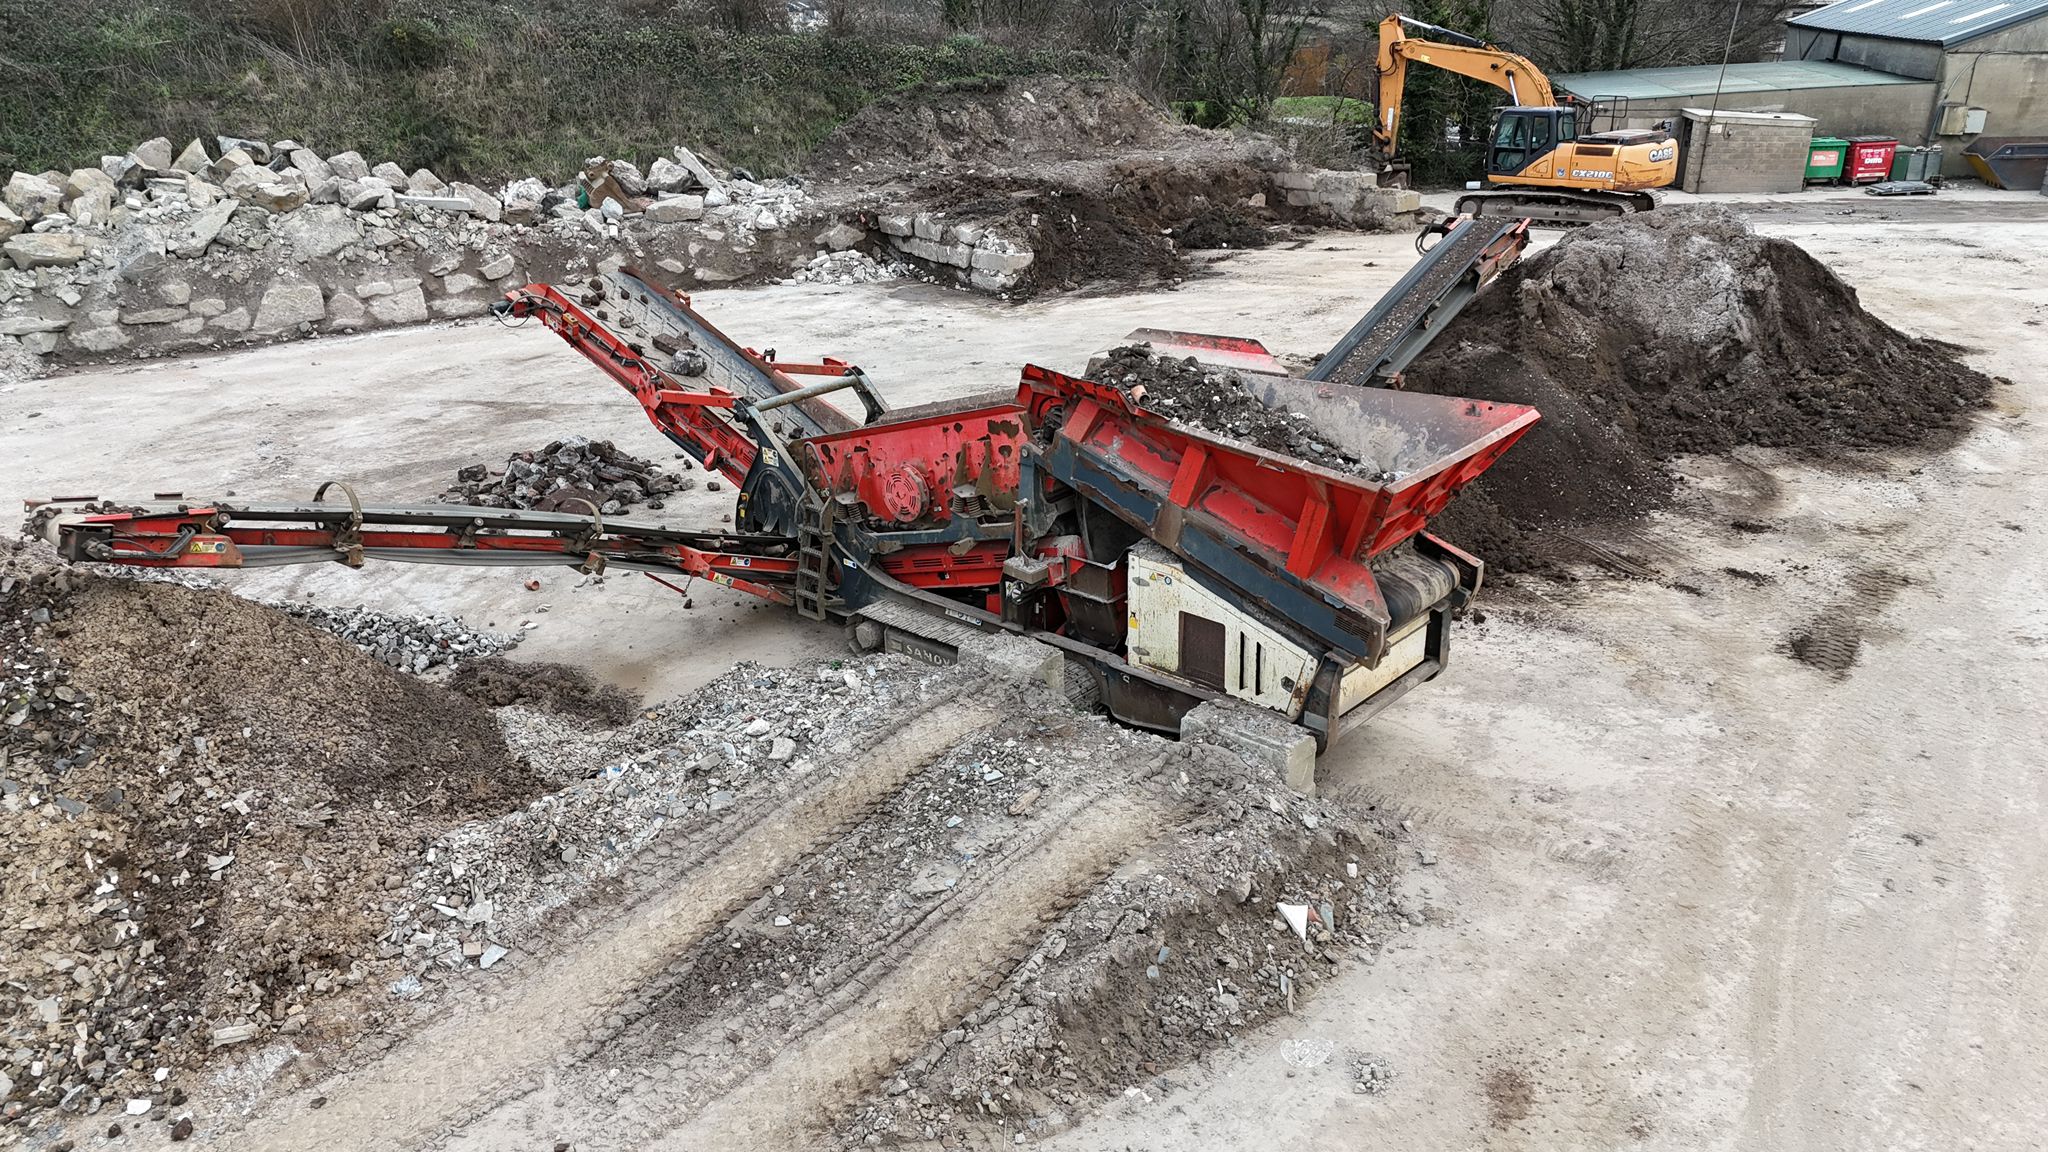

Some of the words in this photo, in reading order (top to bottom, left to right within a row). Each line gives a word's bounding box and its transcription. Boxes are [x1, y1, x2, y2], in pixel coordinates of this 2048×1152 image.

[1649, 147, 1673, 162] CASE
[1572, 169, 1613, 179] CX210C
[906, 644, 953, 667] SANDV
